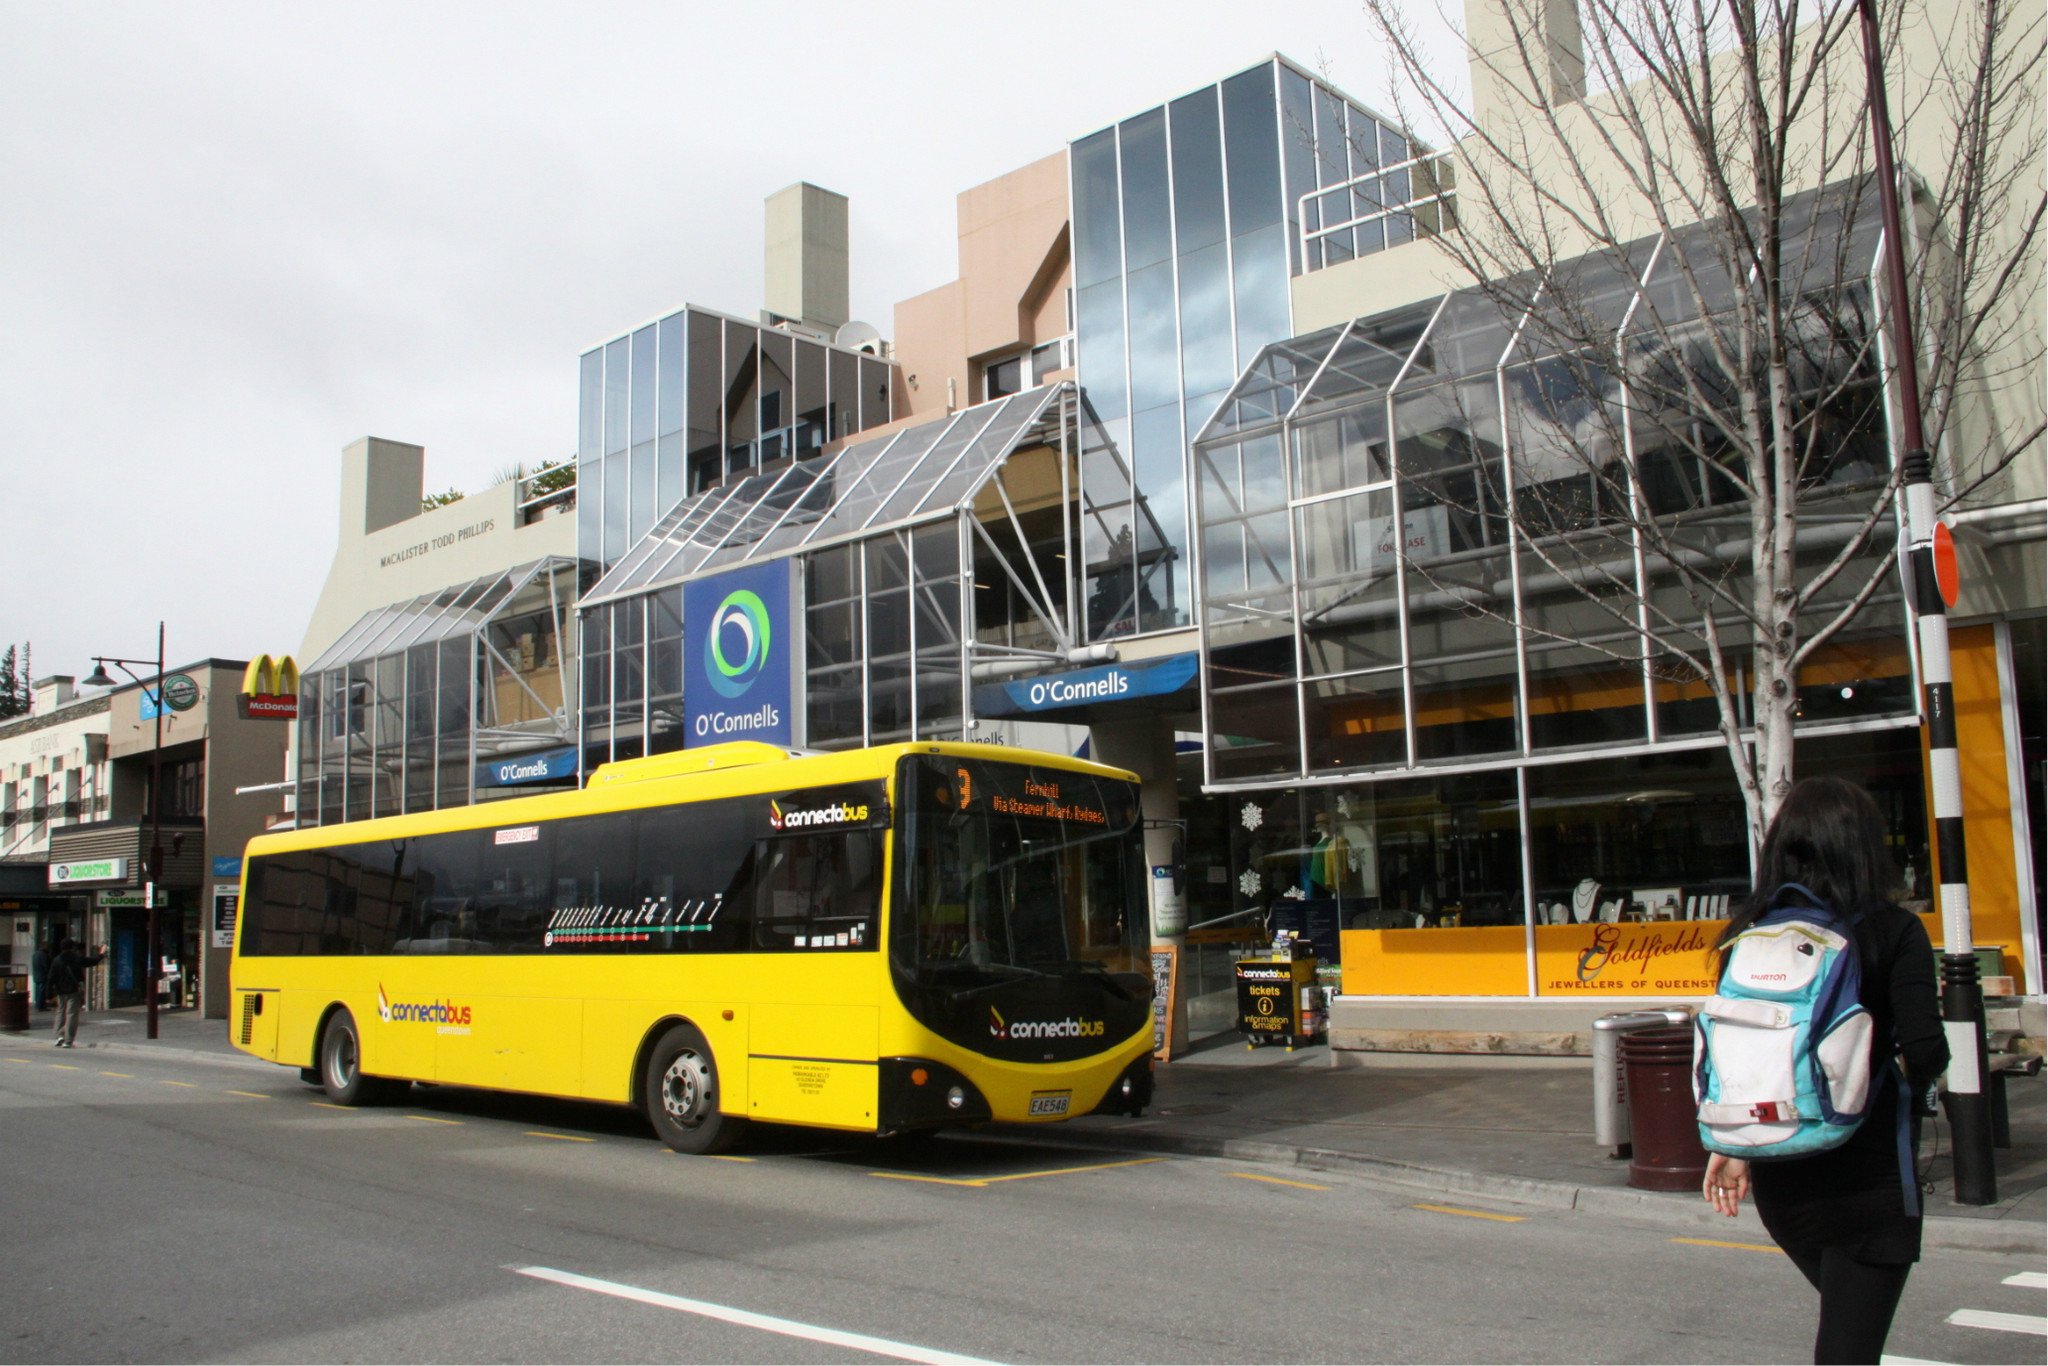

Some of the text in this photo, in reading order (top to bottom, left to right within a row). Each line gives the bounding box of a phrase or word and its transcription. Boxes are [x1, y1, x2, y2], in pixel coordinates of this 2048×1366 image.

[380, 519, 495, 568] MACALISTER TODD PHILLIPS
[1030, 672, 1128, 704] O'Connells
[695, 704, 779, 736] O'Connells
[501, 760, 548, 780] O'Connells
[957, 769, 972, 810] 3
[1025, 780, 1060, 798] Fernhill
[784, 802, 868, 827] connectabus
[993, 796, 1008, 812] Via
[1009, 798, 1045, 816] Steamer
[1578, 923, 1706, 975] Goldfields
[1243, 969, 1291, 978] connectabus
[1249, 985, 1281, 996] tickets
[1548, 981, 1624, 989] JEWELLERS
[1631, 980, 1647, 988] OF
[392, 999, 472, 1025] connectabus
[1245, 1015, 1289, 1024] information
[1010, 1017, 1104, 1039] connectabus
[1252, 1021, 1282, 1031] &maps
[1031, 1099, 1068, 1113] EAE548
